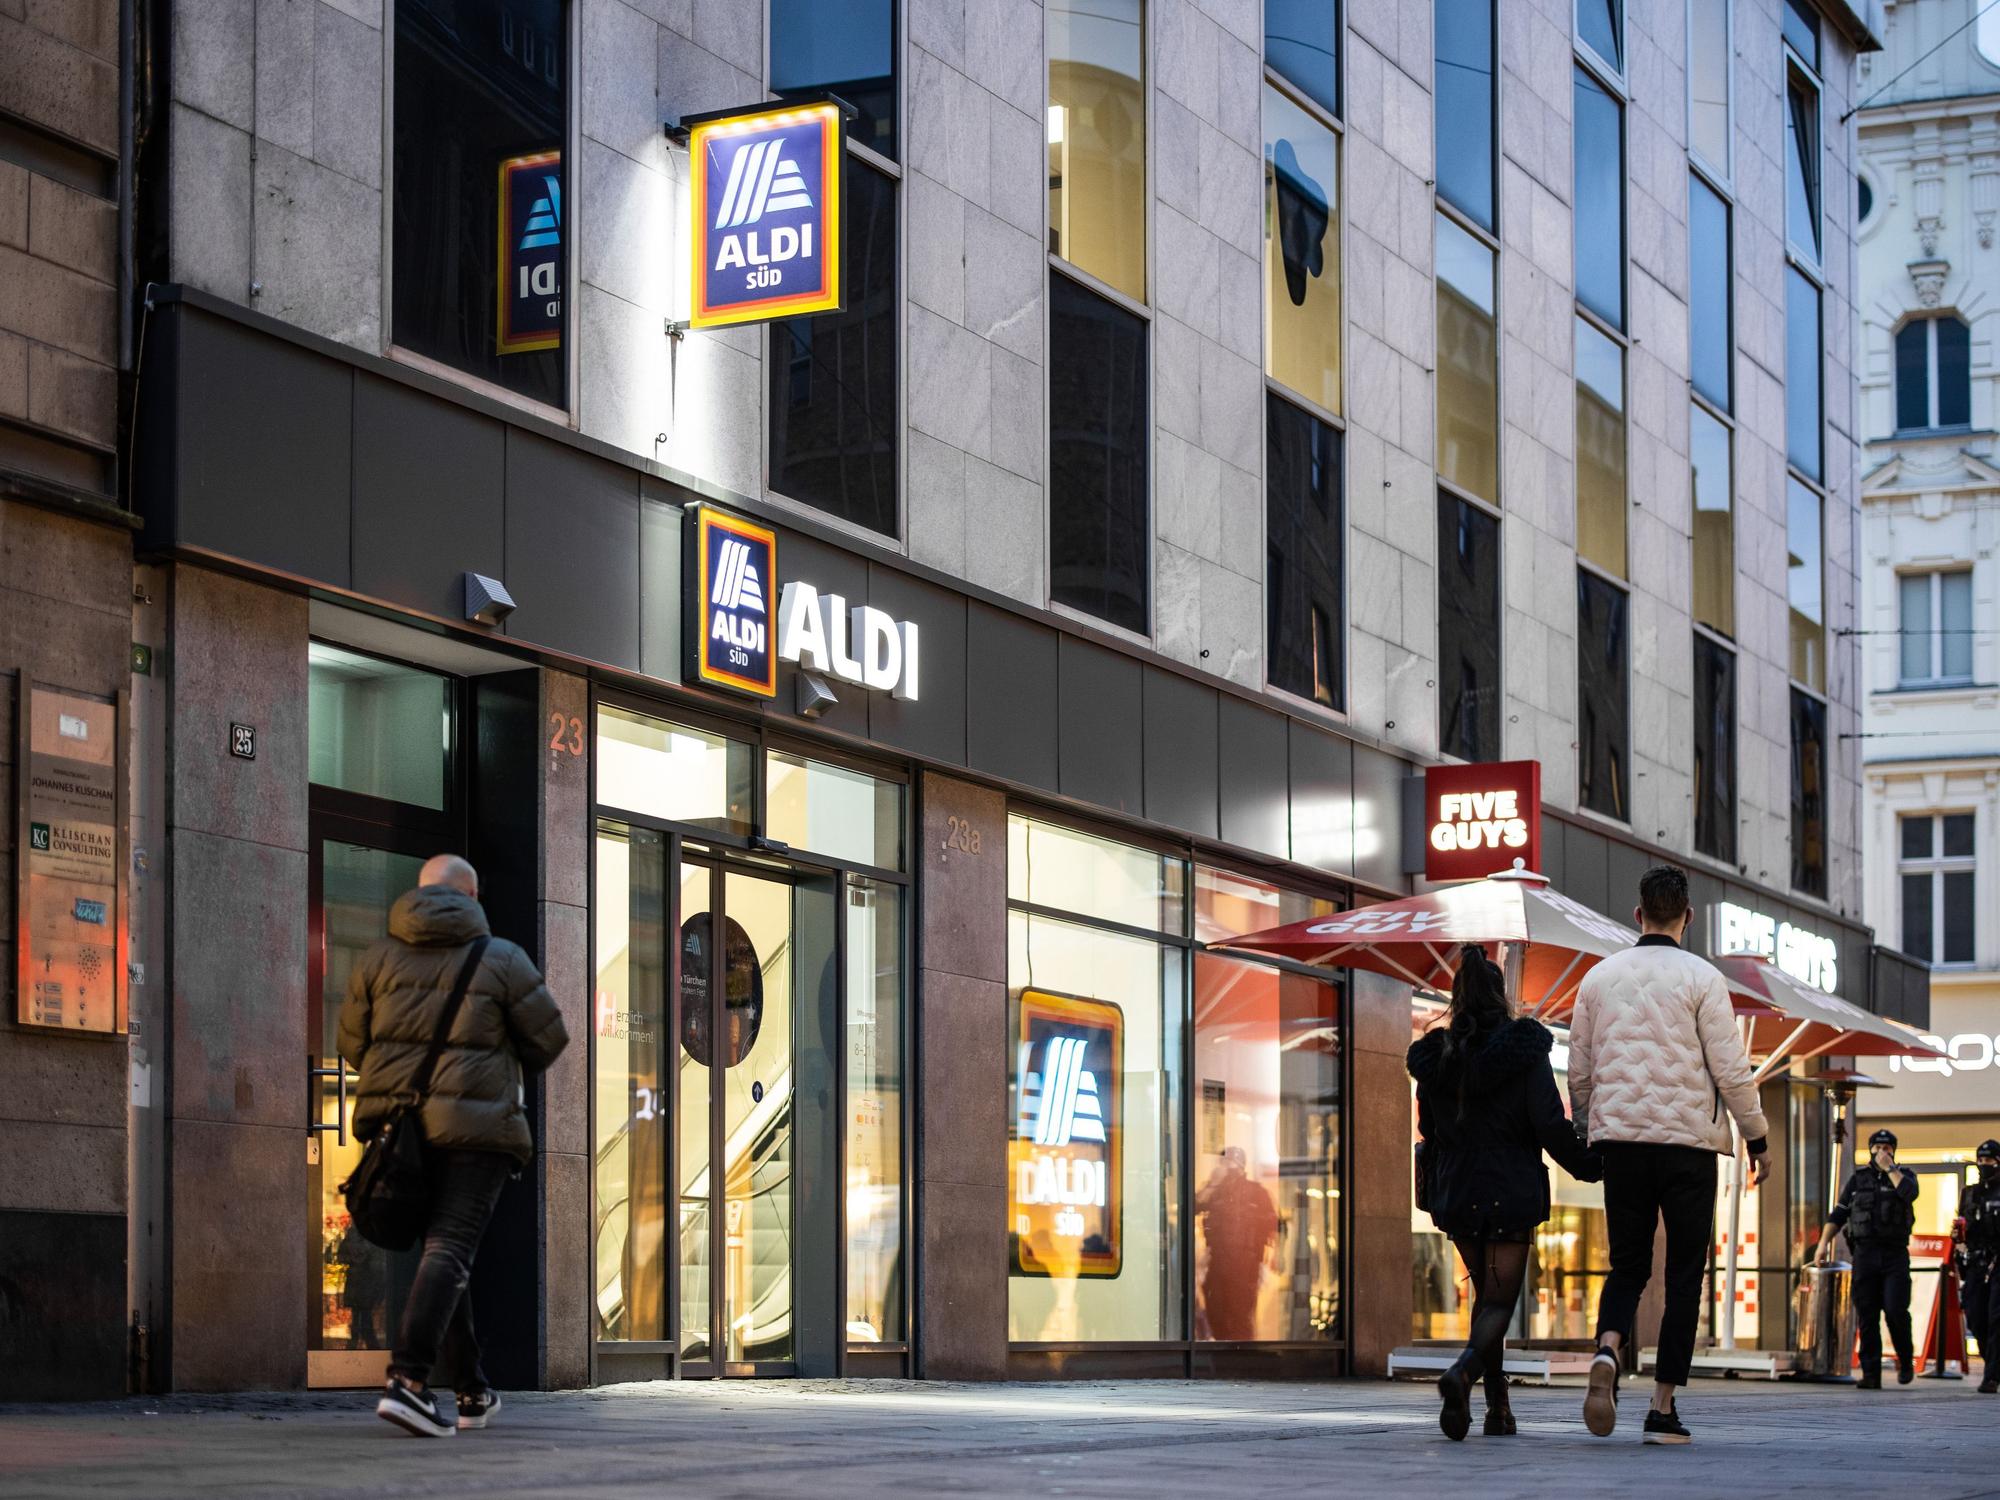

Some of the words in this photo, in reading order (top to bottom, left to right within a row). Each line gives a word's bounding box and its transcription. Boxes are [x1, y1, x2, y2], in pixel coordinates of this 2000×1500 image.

[715, 223, 812, 271] ALDI
[746, 265, 782, 290] SÜD
[711, 610, 765, 653] ALDI
[778, 581, 919, 701] ALDI
[729, 647, 749, 667] SÜD
[235, 728, 253, 754] 25
[550, 712, 584, 756] 23
[32, 777, 73, 793] JOHANNES
[1440, 790, 1518, 822] FIVE
[33, 828, 48, 847] KC
[53, 827, 111, 845] KLISCHAN
[53, 841, 111, 858] CONSULTING
[947, 815, 981, 855] 23a
[1430, 818, 1528, 851] GUYS
[1305, 922, 1465, 934] GUY
[1344, 911, 1462, 922] FIV
[1719, 901, 1776, 964] FIVE
[1776, 922, 1838, 994] GUYS
[1889, 1033, 2000, 1077] QO
[1034, 1156, 1105, 1206] ALDI
